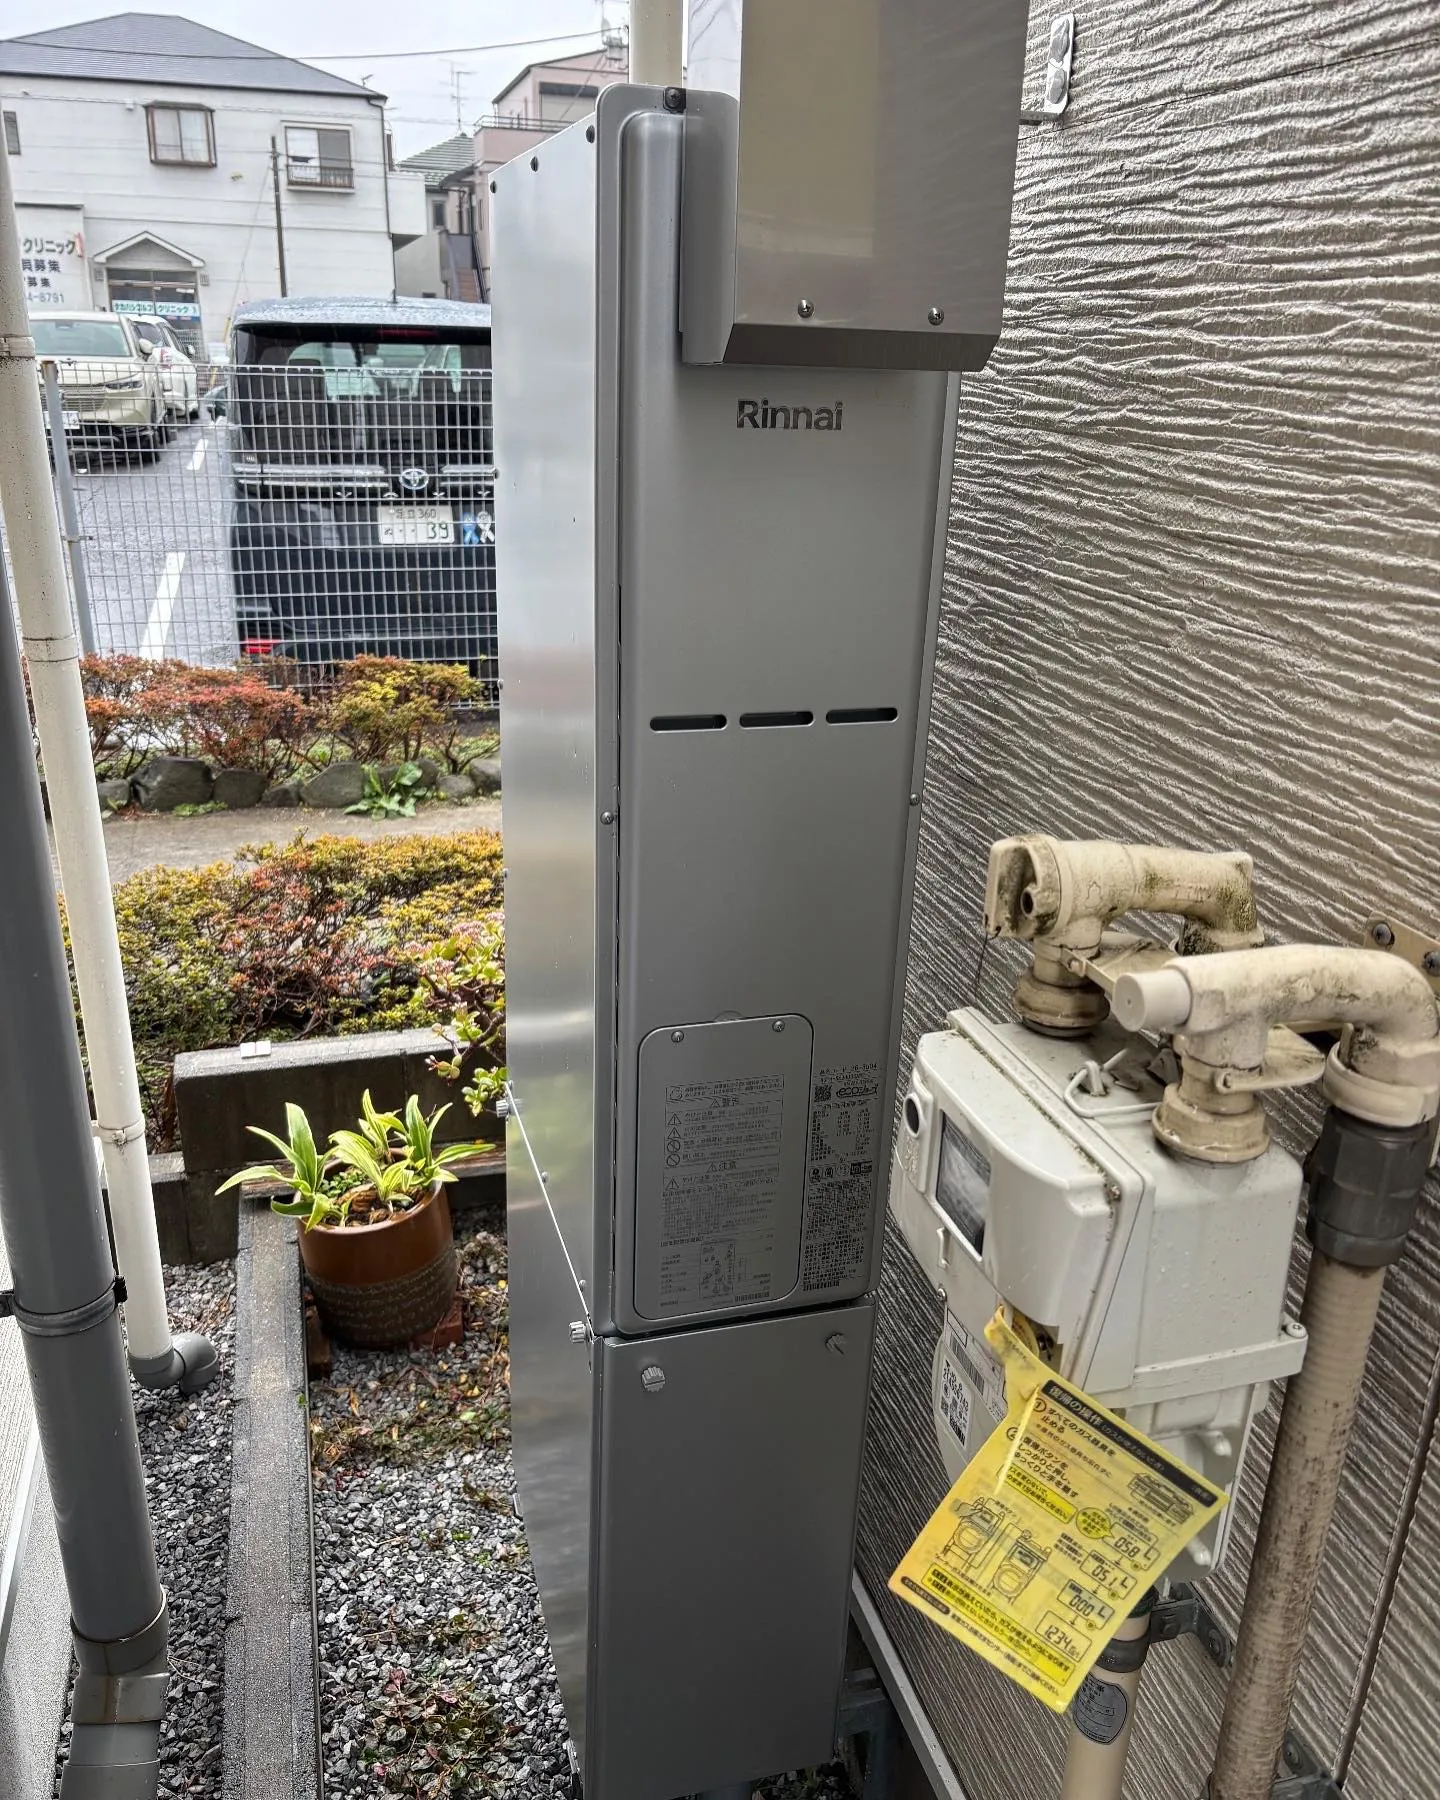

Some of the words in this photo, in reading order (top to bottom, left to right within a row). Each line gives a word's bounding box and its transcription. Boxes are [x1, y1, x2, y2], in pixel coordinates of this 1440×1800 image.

[737, 398, 843, 430] Rinnai
[1040, 1414, 1066, 1434] 止める
[1068, 1593, 1095, 1618] 000
